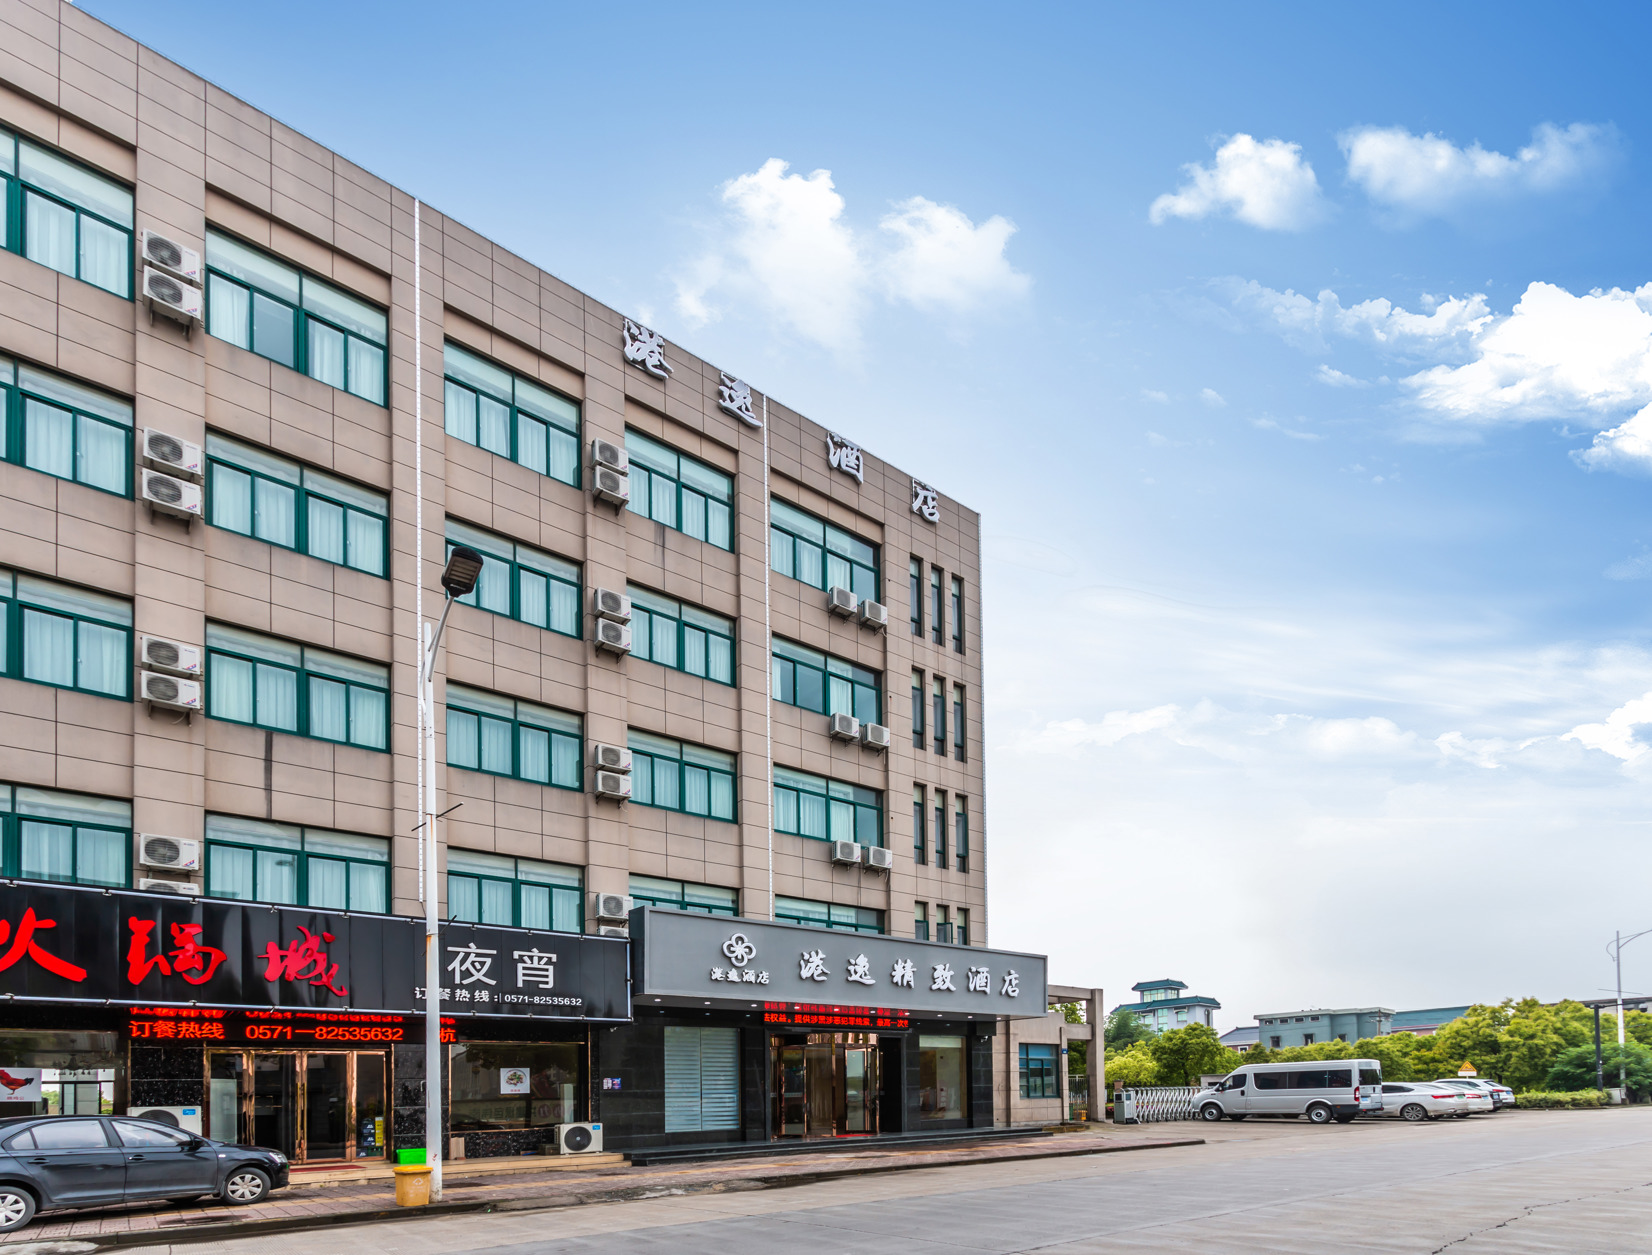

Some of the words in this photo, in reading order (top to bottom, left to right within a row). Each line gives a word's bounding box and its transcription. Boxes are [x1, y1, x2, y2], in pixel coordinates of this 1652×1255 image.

[446, 942, 557, 989] 夜宵
[711, 967, 770, 985] 港逸酒店
[799, 948, 1020, 997] 港逸精致酒店
[128, 1020, 226, 1039] 订餐热线
[439, 1027, 457, 1043] 杭
